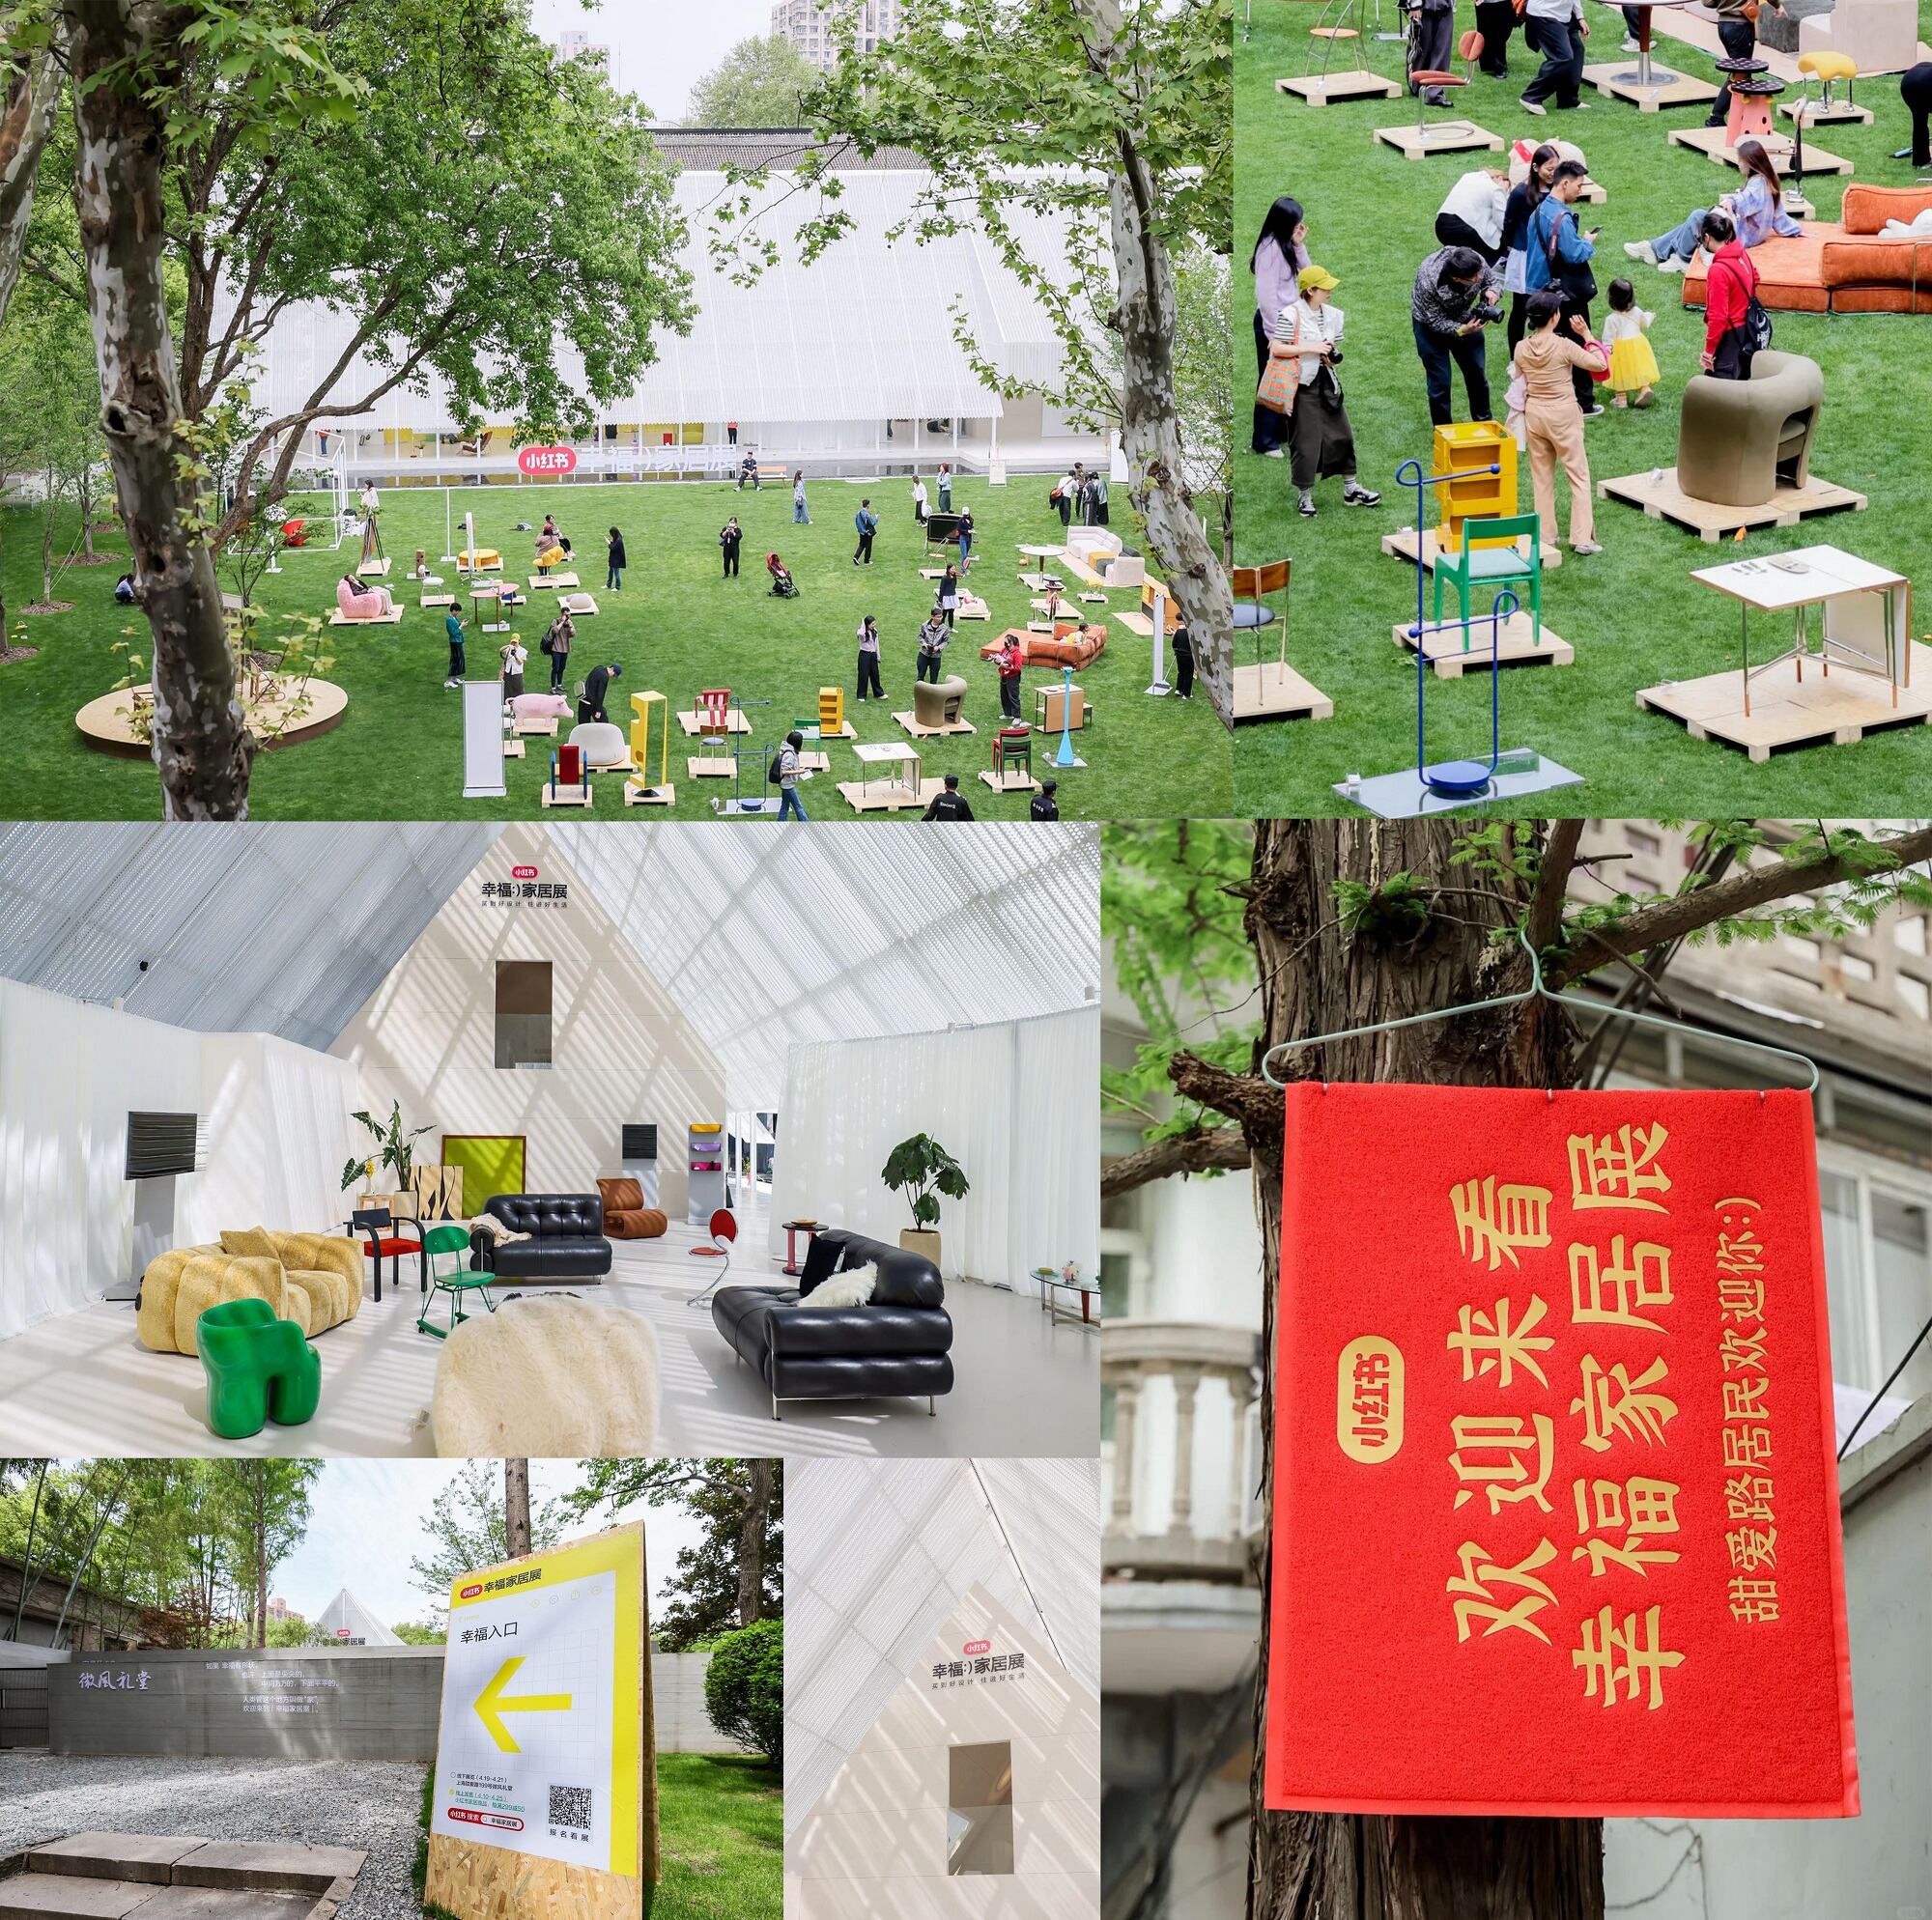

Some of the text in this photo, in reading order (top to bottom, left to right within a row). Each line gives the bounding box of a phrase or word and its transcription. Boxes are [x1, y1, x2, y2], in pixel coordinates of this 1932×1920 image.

[526, 453, 569, 469] 小红书
[481, 882, 568, 899] 幸福:)家居展
[1351, 1351, 1390, 1447] 小红书
[1446, 1173, 1559, 1647] 欢迎来看
[1566, 1120, 1687, 1711] 幸福家居展
[1714, 1196, 1783, 1624] 甜爱路居民欢迎你:)
[463, 1568, 542, 1597] 小红书 幸福家居展
[460, 1622, 518, 1644] 幸福入口
[967, 1643, 987, 1652] 小红书
[932, 1652, 1025, 1680] 幸福:)家居展
[78, 1670, 152, 1690] 微风礼堂
[449, 1810, 466, 1819] 小红书
[491, 1817, 518, 1827] 幸福家居展
[550, 1828, 589, 1843] 报名看展
